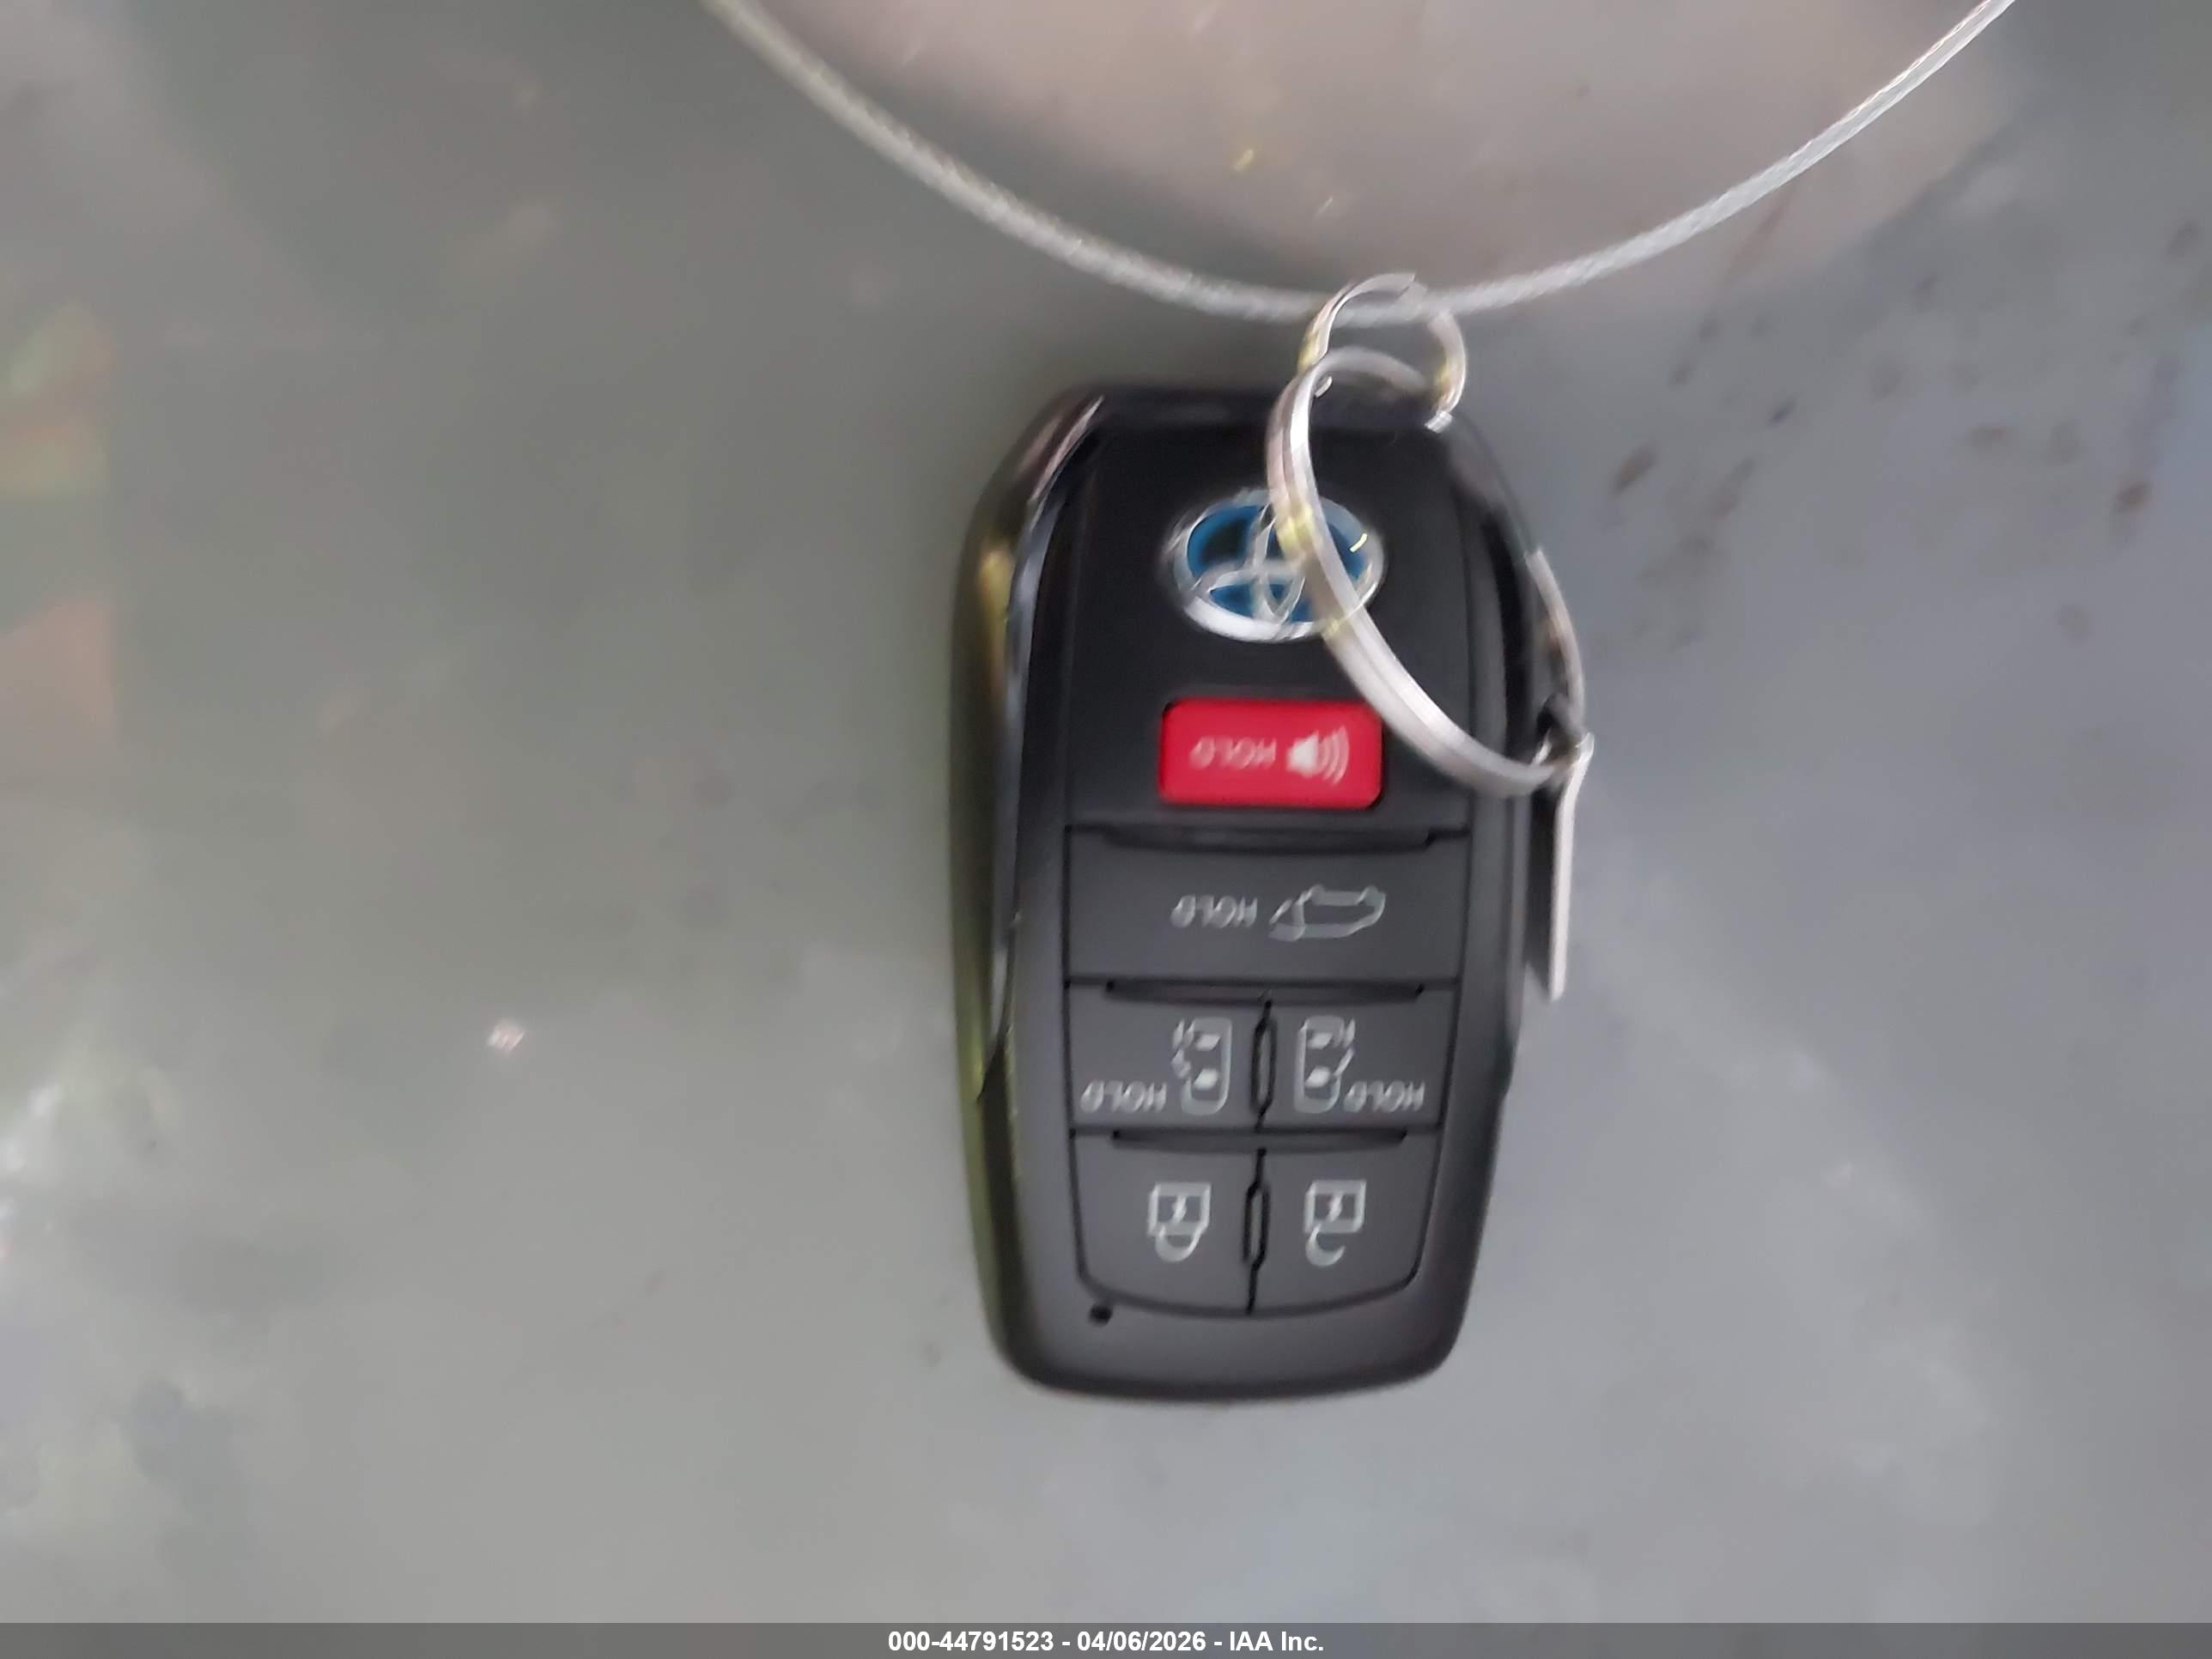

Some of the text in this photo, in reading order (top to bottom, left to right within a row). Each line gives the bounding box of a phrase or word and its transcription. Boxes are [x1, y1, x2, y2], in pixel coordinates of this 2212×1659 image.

[1189, 736, 1277, 769] HOLD
[1170, 895, 1258, 928] HOLD
[1079, 1079, 1167, 1114] HOLD
[1343, 1079, 1425, 1114] HOLD
